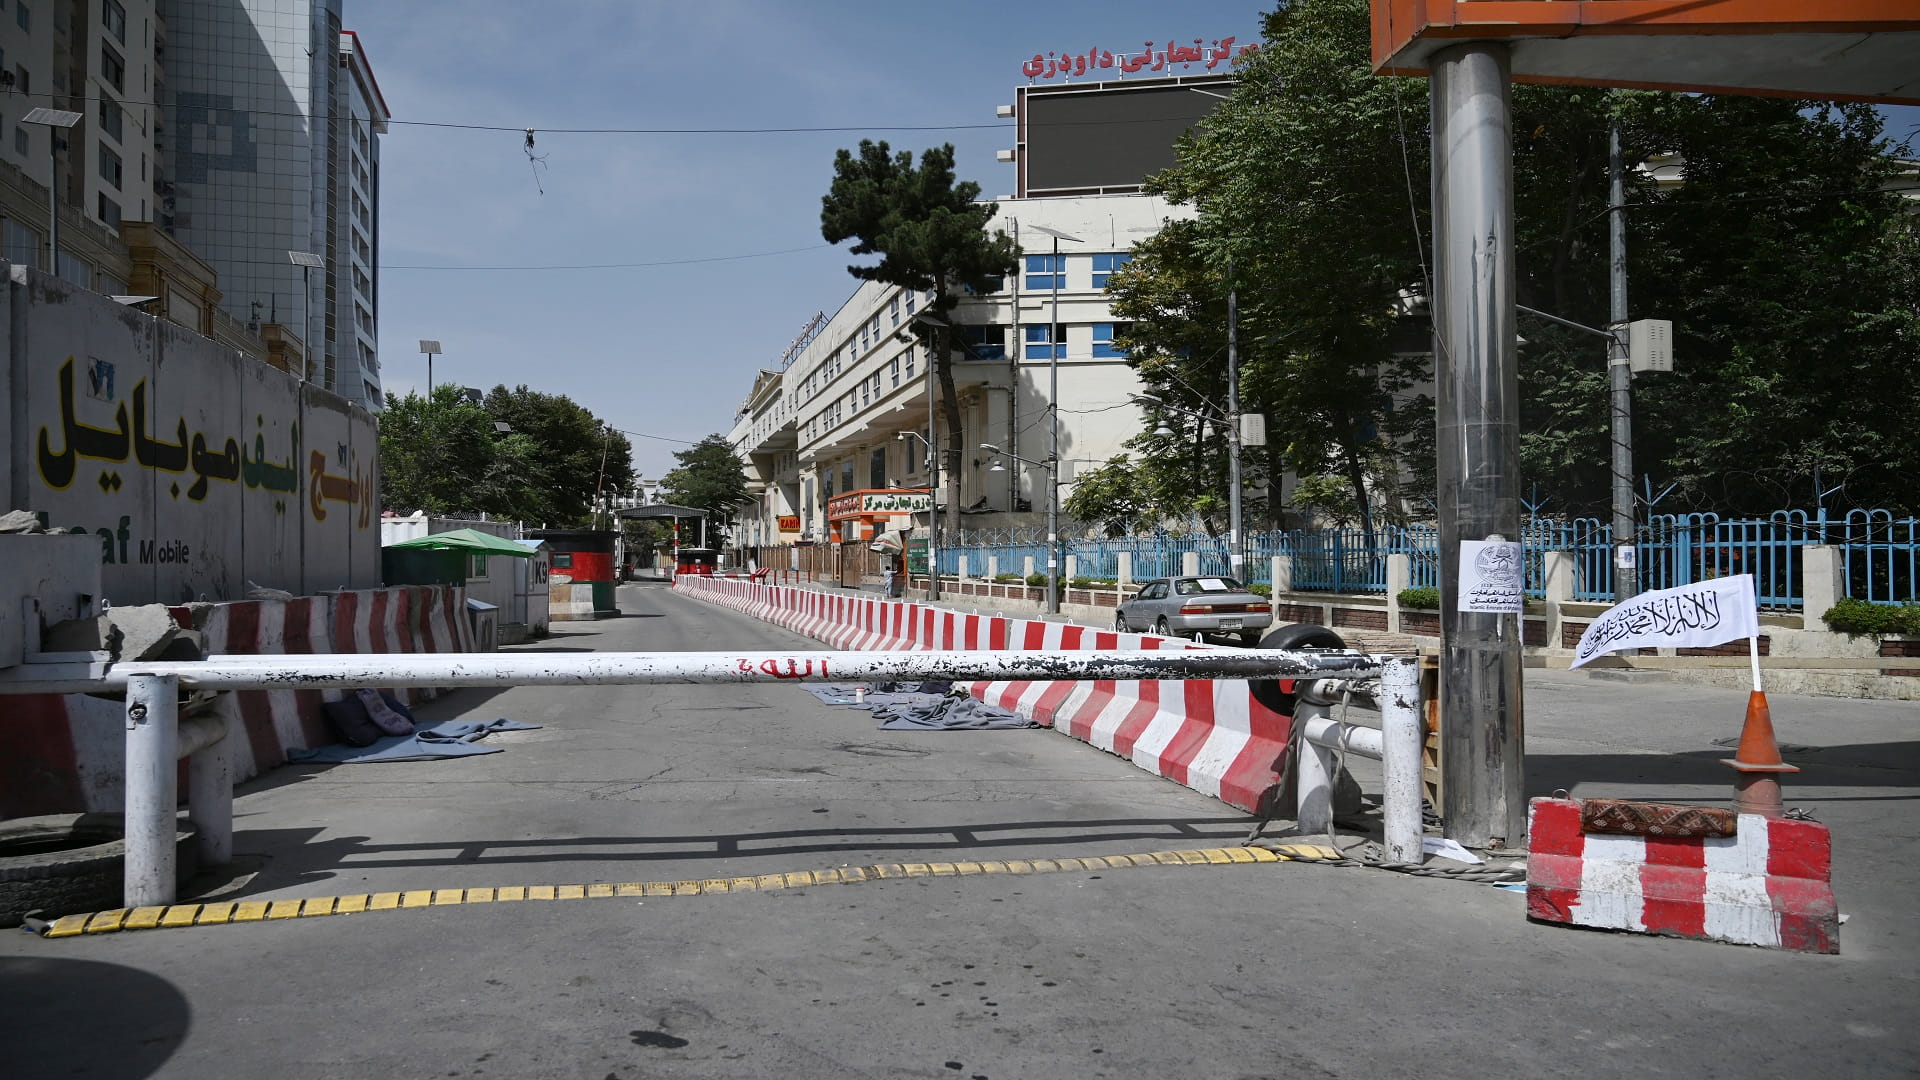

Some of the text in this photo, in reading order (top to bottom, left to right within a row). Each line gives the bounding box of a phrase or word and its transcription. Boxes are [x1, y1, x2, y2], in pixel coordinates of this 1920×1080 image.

[1023, 46, 1113, 79] داودزی
[1120, 38, 1204, 72] تجارتی
[139, 539, 190, 564] Mobile
[535, 560, 548, 585] K9
